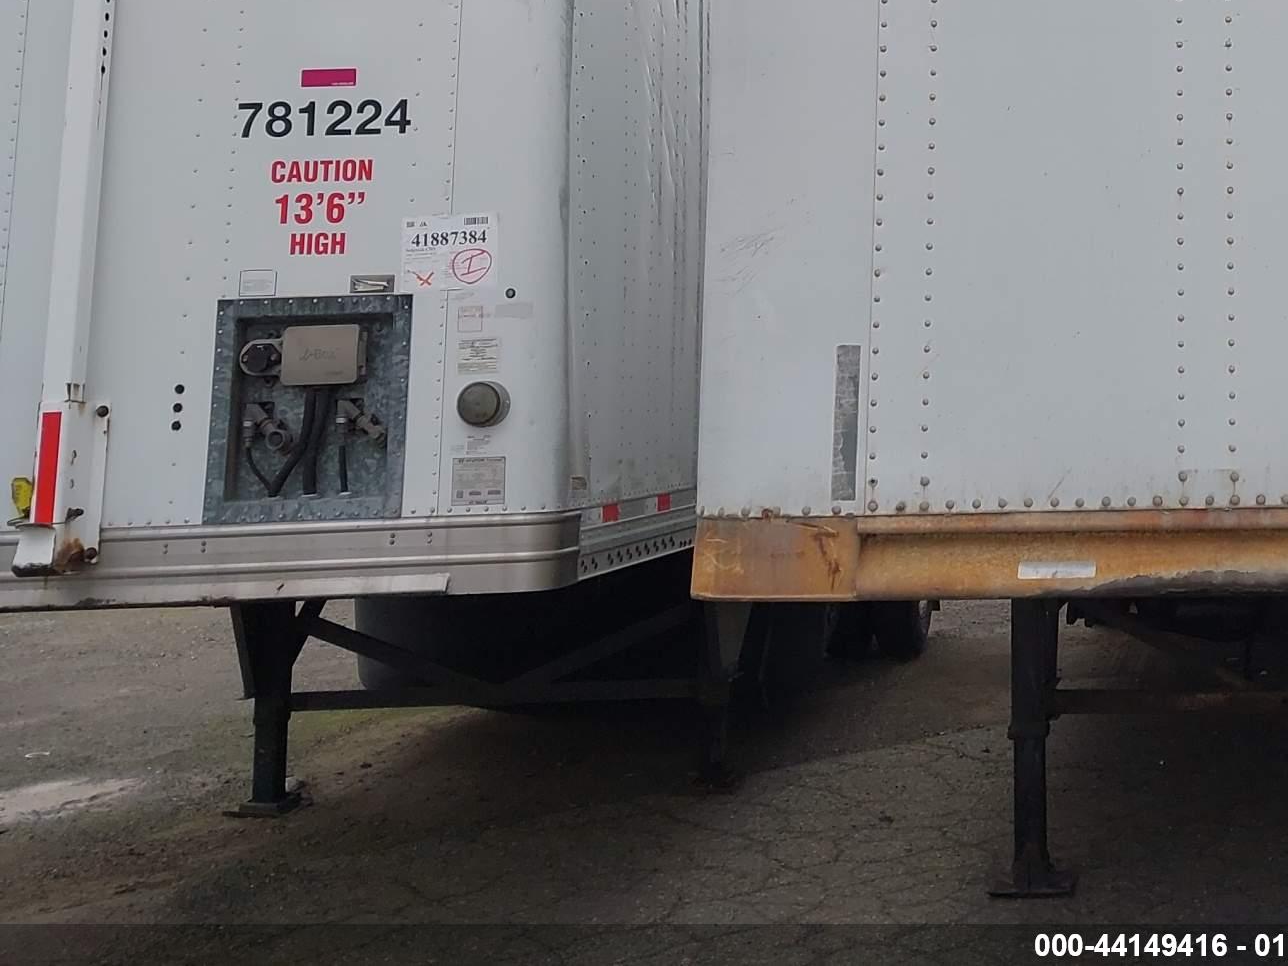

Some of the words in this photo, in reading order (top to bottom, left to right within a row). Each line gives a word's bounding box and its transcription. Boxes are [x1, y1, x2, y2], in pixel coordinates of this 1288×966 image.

[238, 99, 412, 138] 781224
[271, 159, 373, 183] CAUTION
[289, 233, 346, 255] HIGH
[411, 229, 487, 247] 41887384
